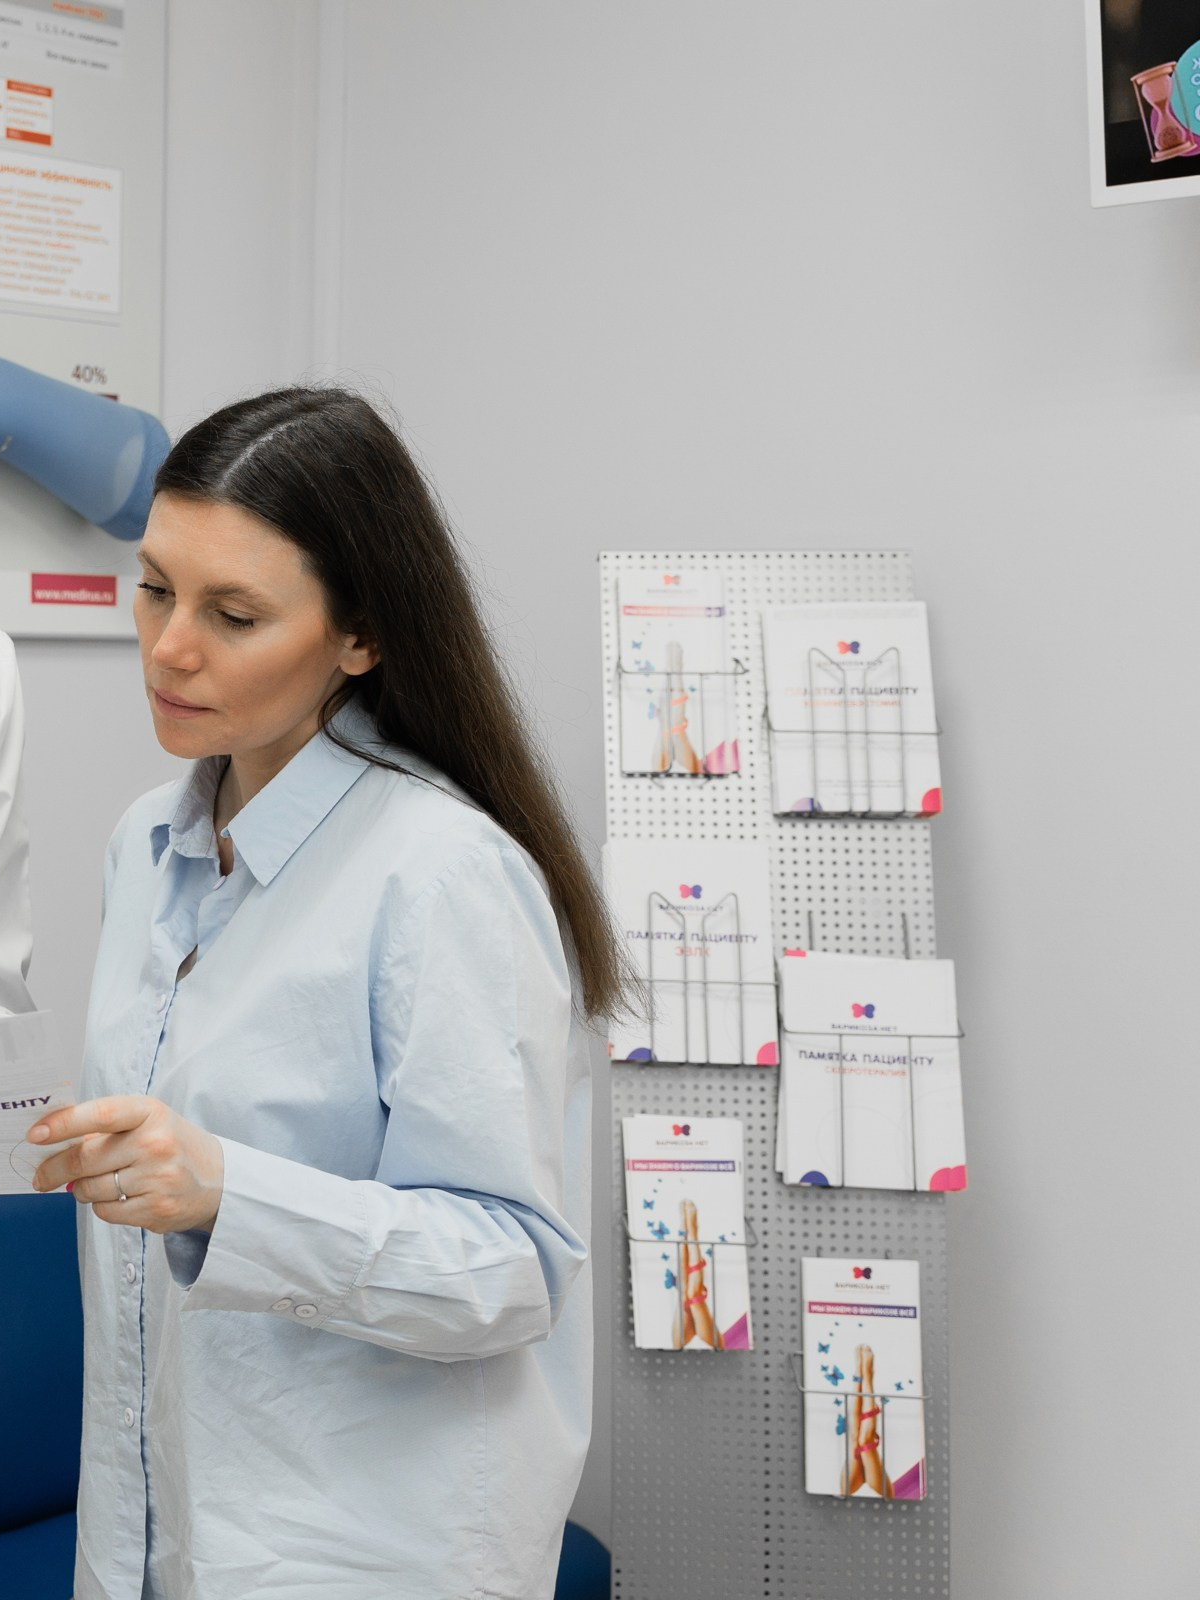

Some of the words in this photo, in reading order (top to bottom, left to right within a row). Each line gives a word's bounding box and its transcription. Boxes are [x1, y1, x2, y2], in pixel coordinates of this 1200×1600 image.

[71, 365, 108, 385] 40%
[626, 930, 685, 942] ПАМЯТКА
[690, 933, 758, 944] ПАЦИЕНТУ
[799, 1050, 858, 1063] ПАМЯТКА
[863, 1053, 934, 1066] ПАЦИЕНТУ
